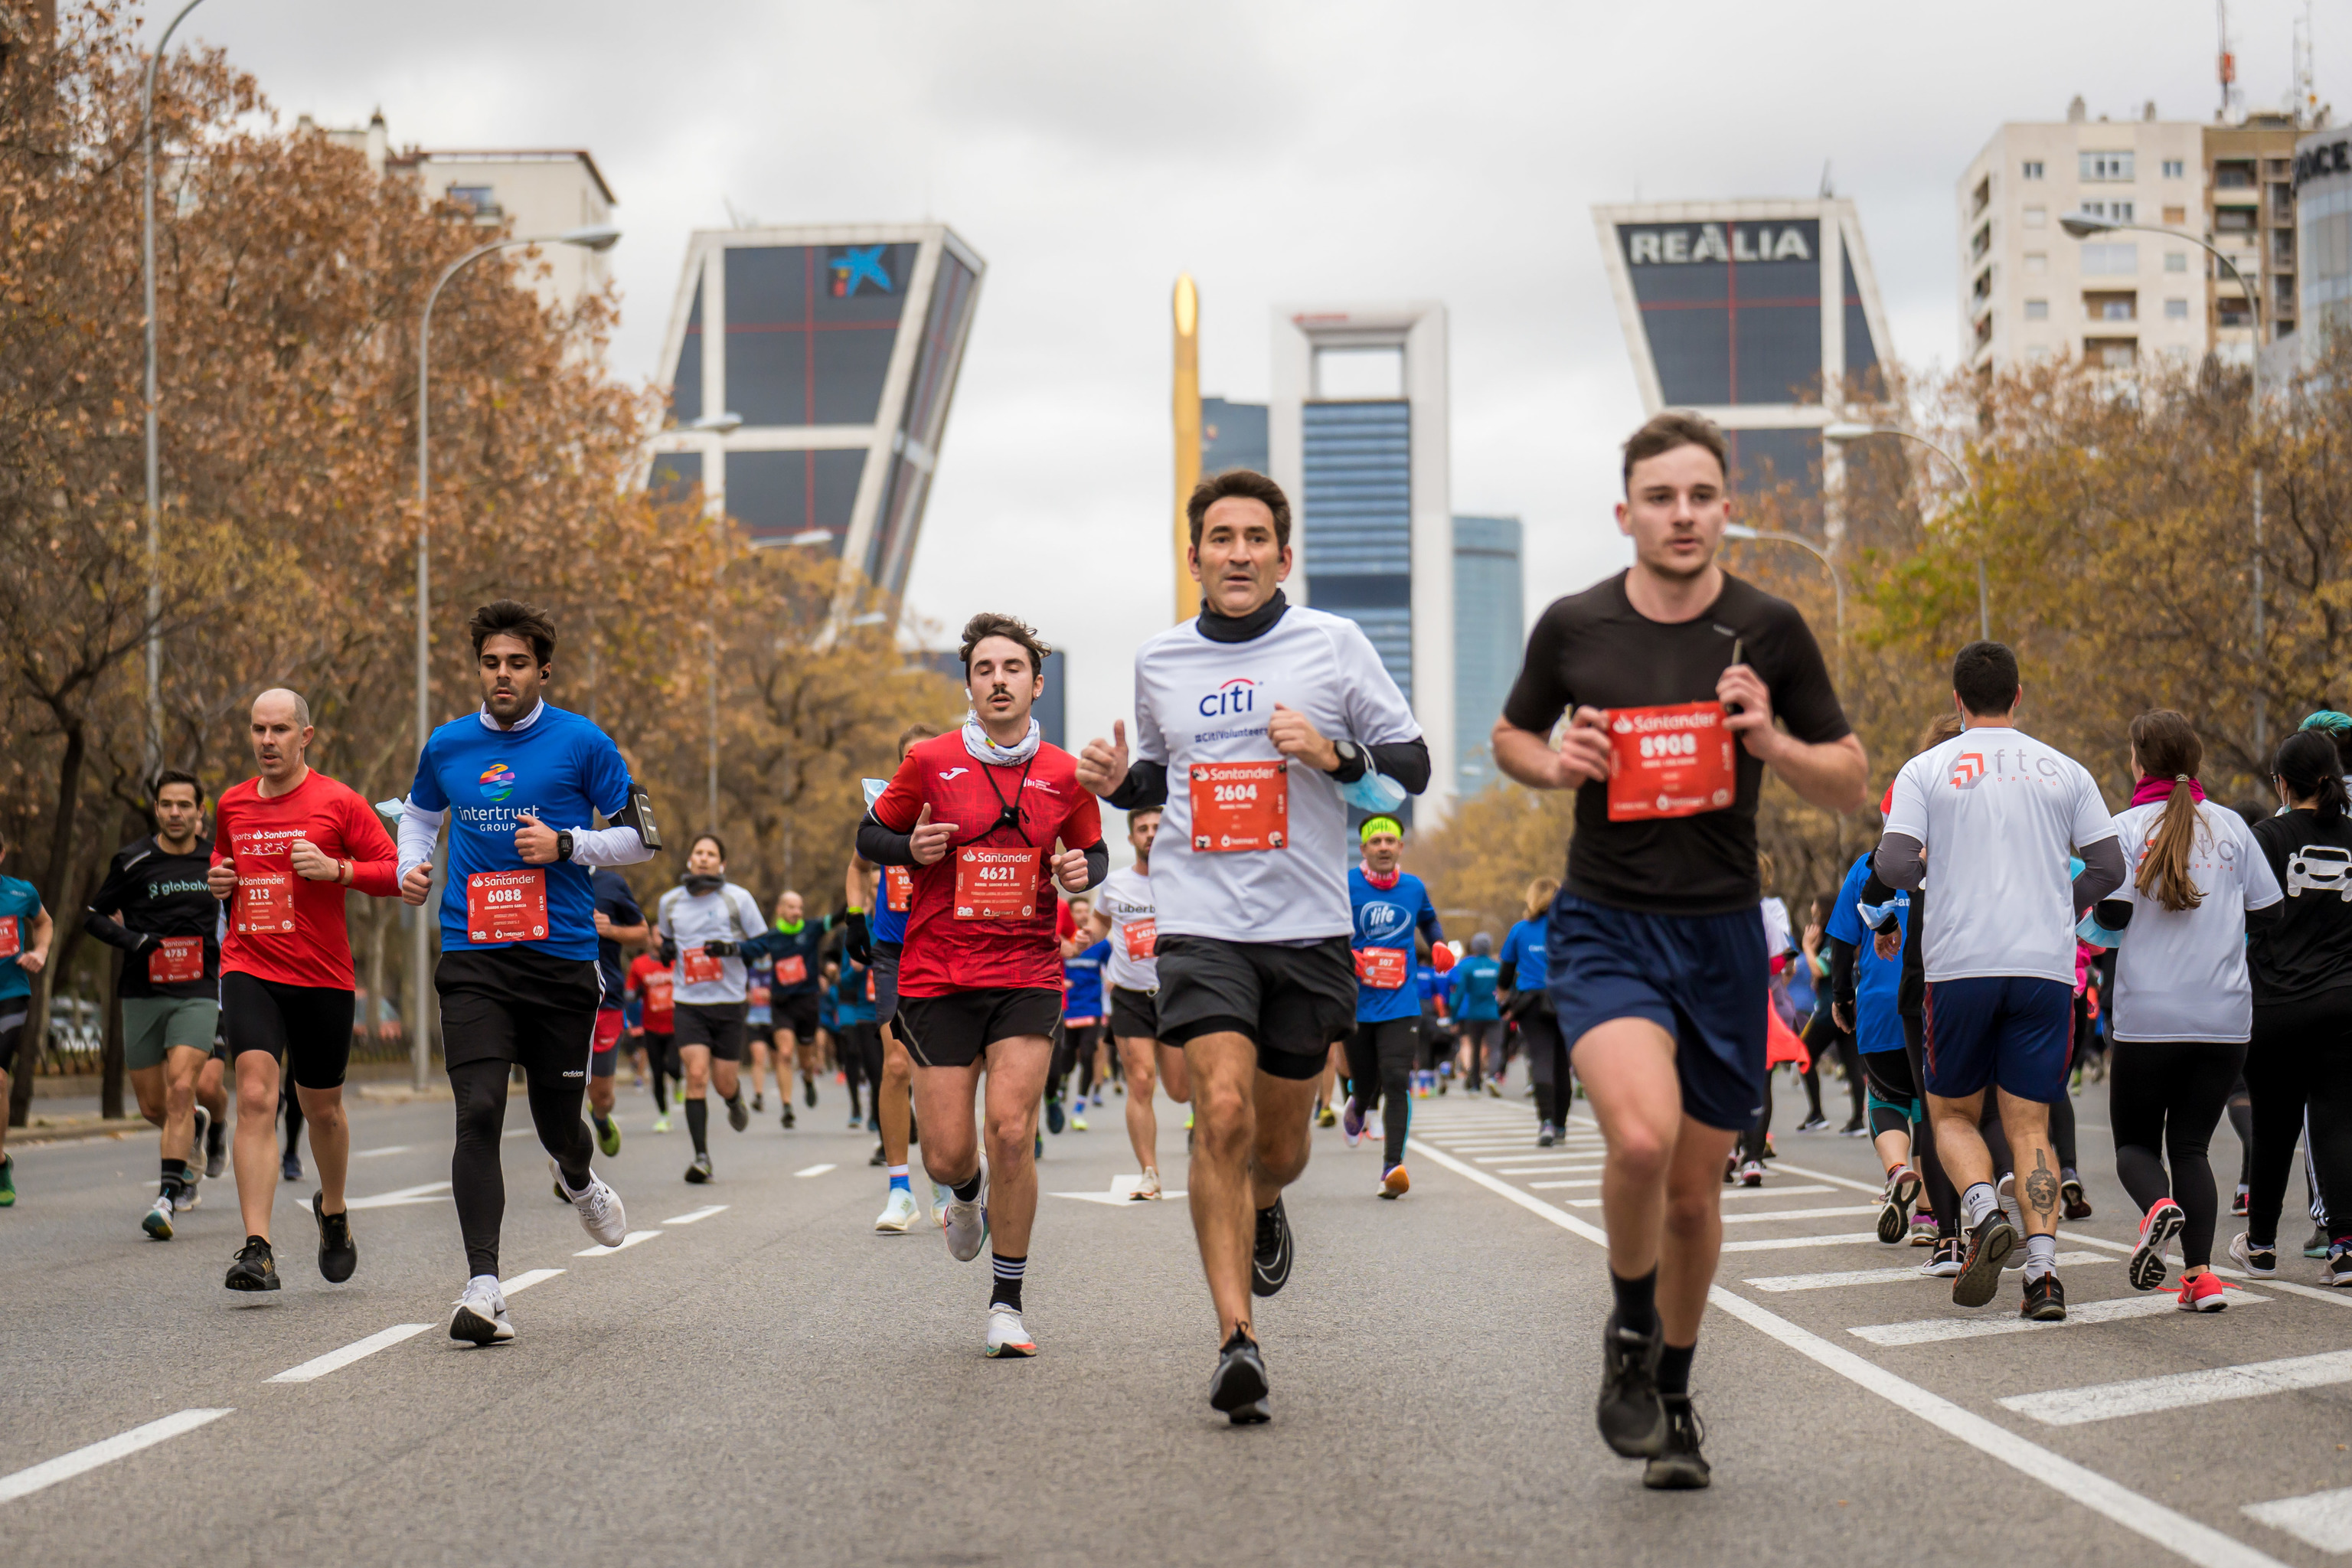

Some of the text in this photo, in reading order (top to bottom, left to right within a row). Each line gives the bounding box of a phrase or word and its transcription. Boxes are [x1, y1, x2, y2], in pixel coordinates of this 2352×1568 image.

[1199, 685, 1253, 717] citi
[1634, 711, 1717, 733] Santander
[1640, 733, 1697, 759] 8908
[1210, 767, 1276, 781] Santander
[1998, 776, 2056, 786] OBRAS
[1214, 783, 1258, 802] 2604
[458, 805, 540, 821] intertrust
[479, 823, 517, 831] GROUP
[232, 828, 307, 842] Sports Santander
[977, 852, 1032, 863] Santander
[979, 867, 1015, 880] 4621
[2194, 863, 2234, 872] BRAS
[245, 874, 286, 886] Santander
[484, 874, 535, 887] Santander
[249, 888, 270, 900] 213
[487, 888, 522, 903] 6088
[539, 895, 544, 904] KM
[1370, 905, 1395, 926] life
